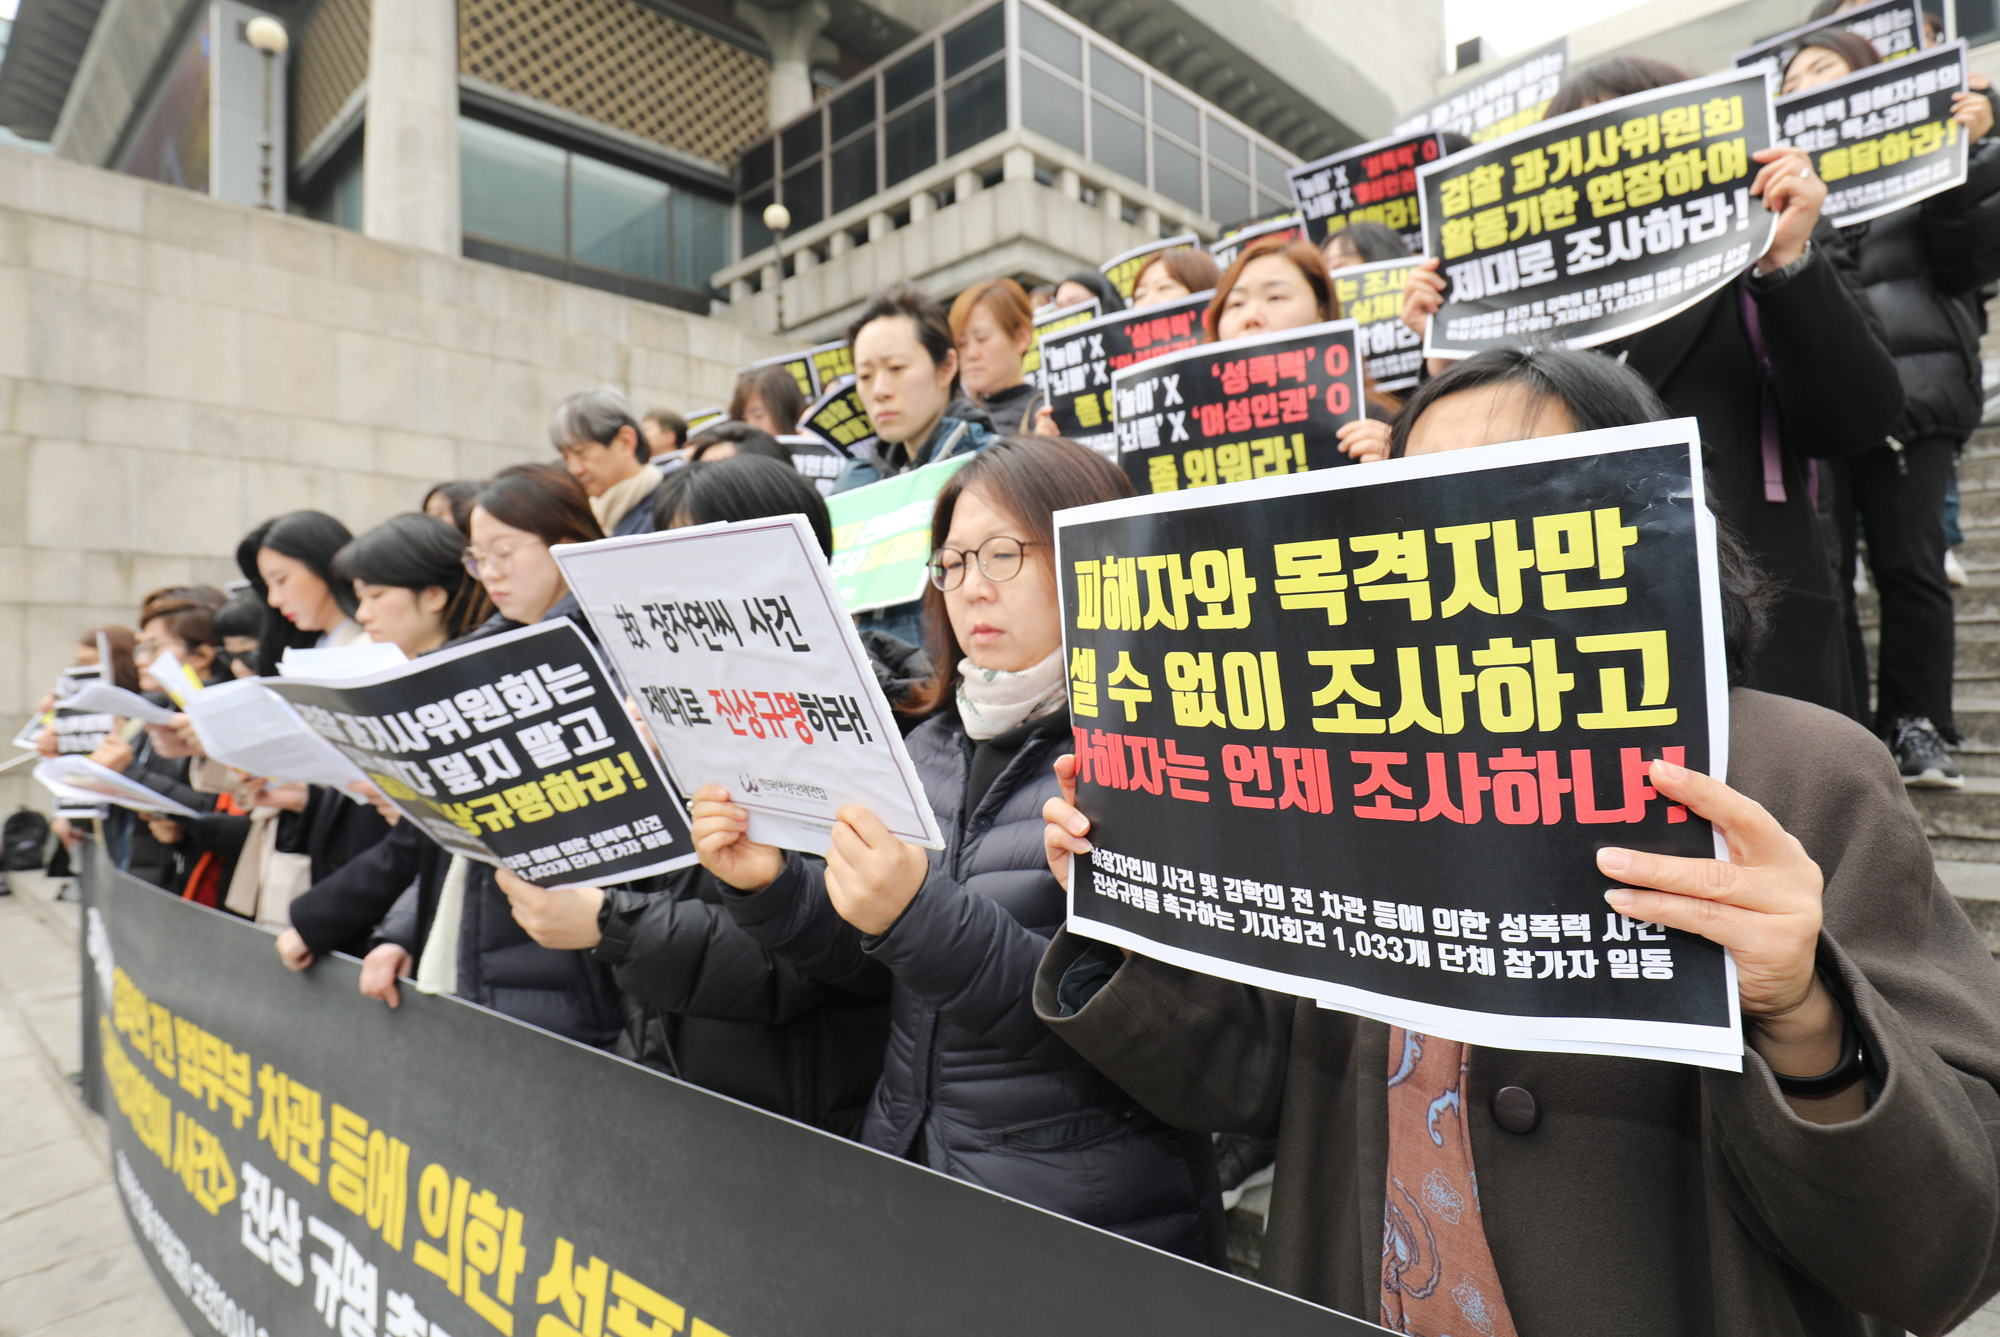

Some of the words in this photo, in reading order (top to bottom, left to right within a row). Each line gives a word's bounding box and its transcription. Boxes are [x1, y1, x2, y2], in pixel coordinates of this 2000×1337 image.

[1440, 162, 1505, 219] 검찰
[1510, 94, 1744, 195] 과거사위원회
[1440, 184, 1579, 260] 활동기한
[1586, 137, 1748, 219] 연장하여
[1363, 266, 1417, 297] 조사
[1446, 239, 1558, 305] 제대로
[1565, 187, 1749, 276] 조사하라!
[1088, 333, 1105, 360] X
[1092, 360, 1109, 386] X
[1162, 374, 1184, 407] X
[1167, 410, 1189, 443] X
[1148, 454, 1178, 494] 좀
[1183, 433, 1309, 490] 외워라!
[1075, 549, 1256, 632] 피해자와
[1274, 507, 1637, 626] 목격자만
[642, 599, 744, 653] 장자연씨
[742, 594, 811, 652] 사건
[639, 686, 712, 728] 제대로
[708, 689, 873, 745] 진상규명하라!
[1069, 646, 1098, 715] 셀
[1107, 656, 1153, 722] 수
[1164, 651, 1286, 731] 없이
[1308, 629, 1678, 735] 조사하고
[427, 737, 521, 796] 덮지
[515, 705, 616, 769] 말고
[1072, 725, 1210, 803] 가해자는
[1223, 744, 1334, 815] 언제
[1349, 745, 1688, 826] 조사하냐!
[632, 814, 664, 836] 사건
[1092, 871, 1160, 914] 진상규명을
[1162, 892, 1235, 932] 촉구하는
[1239, 908, 1327, 948] 기자회견
[1333, 926, 1431, 968] 1,033개
[1437, 942, 1497, 977] 단체
[1502, 947, 1600, 980] 참가자
[1607, 948, 1674, 980] 일동
[1162, 864, 1196, 895] 사건
[1199, 872, 1220, 899] 및
[1223, 876, 1286, 911] 김학의
[1290, 886, 1315, 915] 전
[1319, 890, 1367, 925] 차관
[1372, 899, 1425, 934] 등에
[1432, 907, 1490, 940] 의한
[1499, 912, 1592, 943] 성폭력
[1602, 912, 1667, 942] 사건
[257, 1064, 325, 1187] 차관
[328, 1103, 410, 1252] 등에
[413, 1163, 527, 1337] 의한
[241, 1161, 305, 1287] 진상
[308, 1214, 378, 1337] 규명
